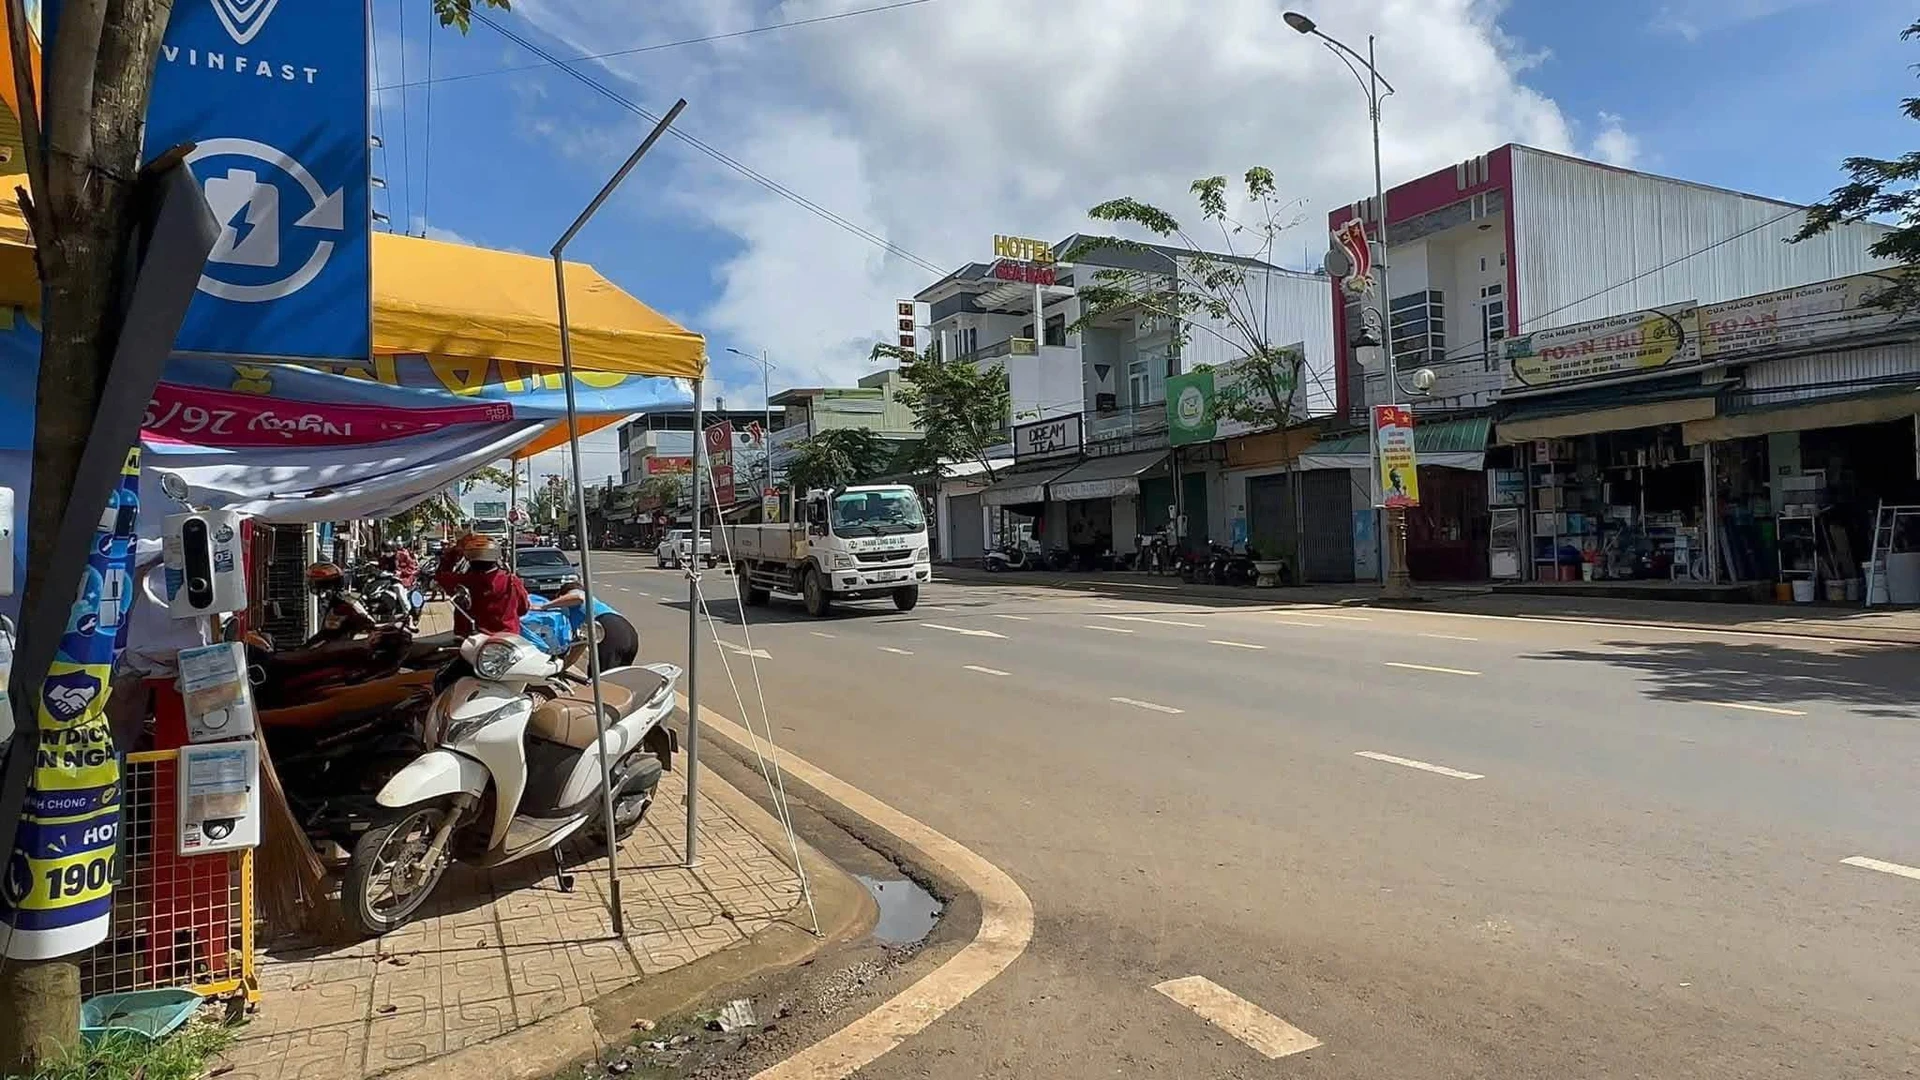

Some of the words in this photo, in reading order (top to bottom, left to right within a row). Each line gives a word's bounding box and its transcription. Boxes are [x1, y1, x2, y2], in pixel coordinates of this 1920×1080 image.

[162, 44, 317, 84] VINFAST
[994, 234, 1054, 263] HOTEL
[1029, 422, 1065, 442] DREAM
[1029, 440, 1056, 453] TEA
